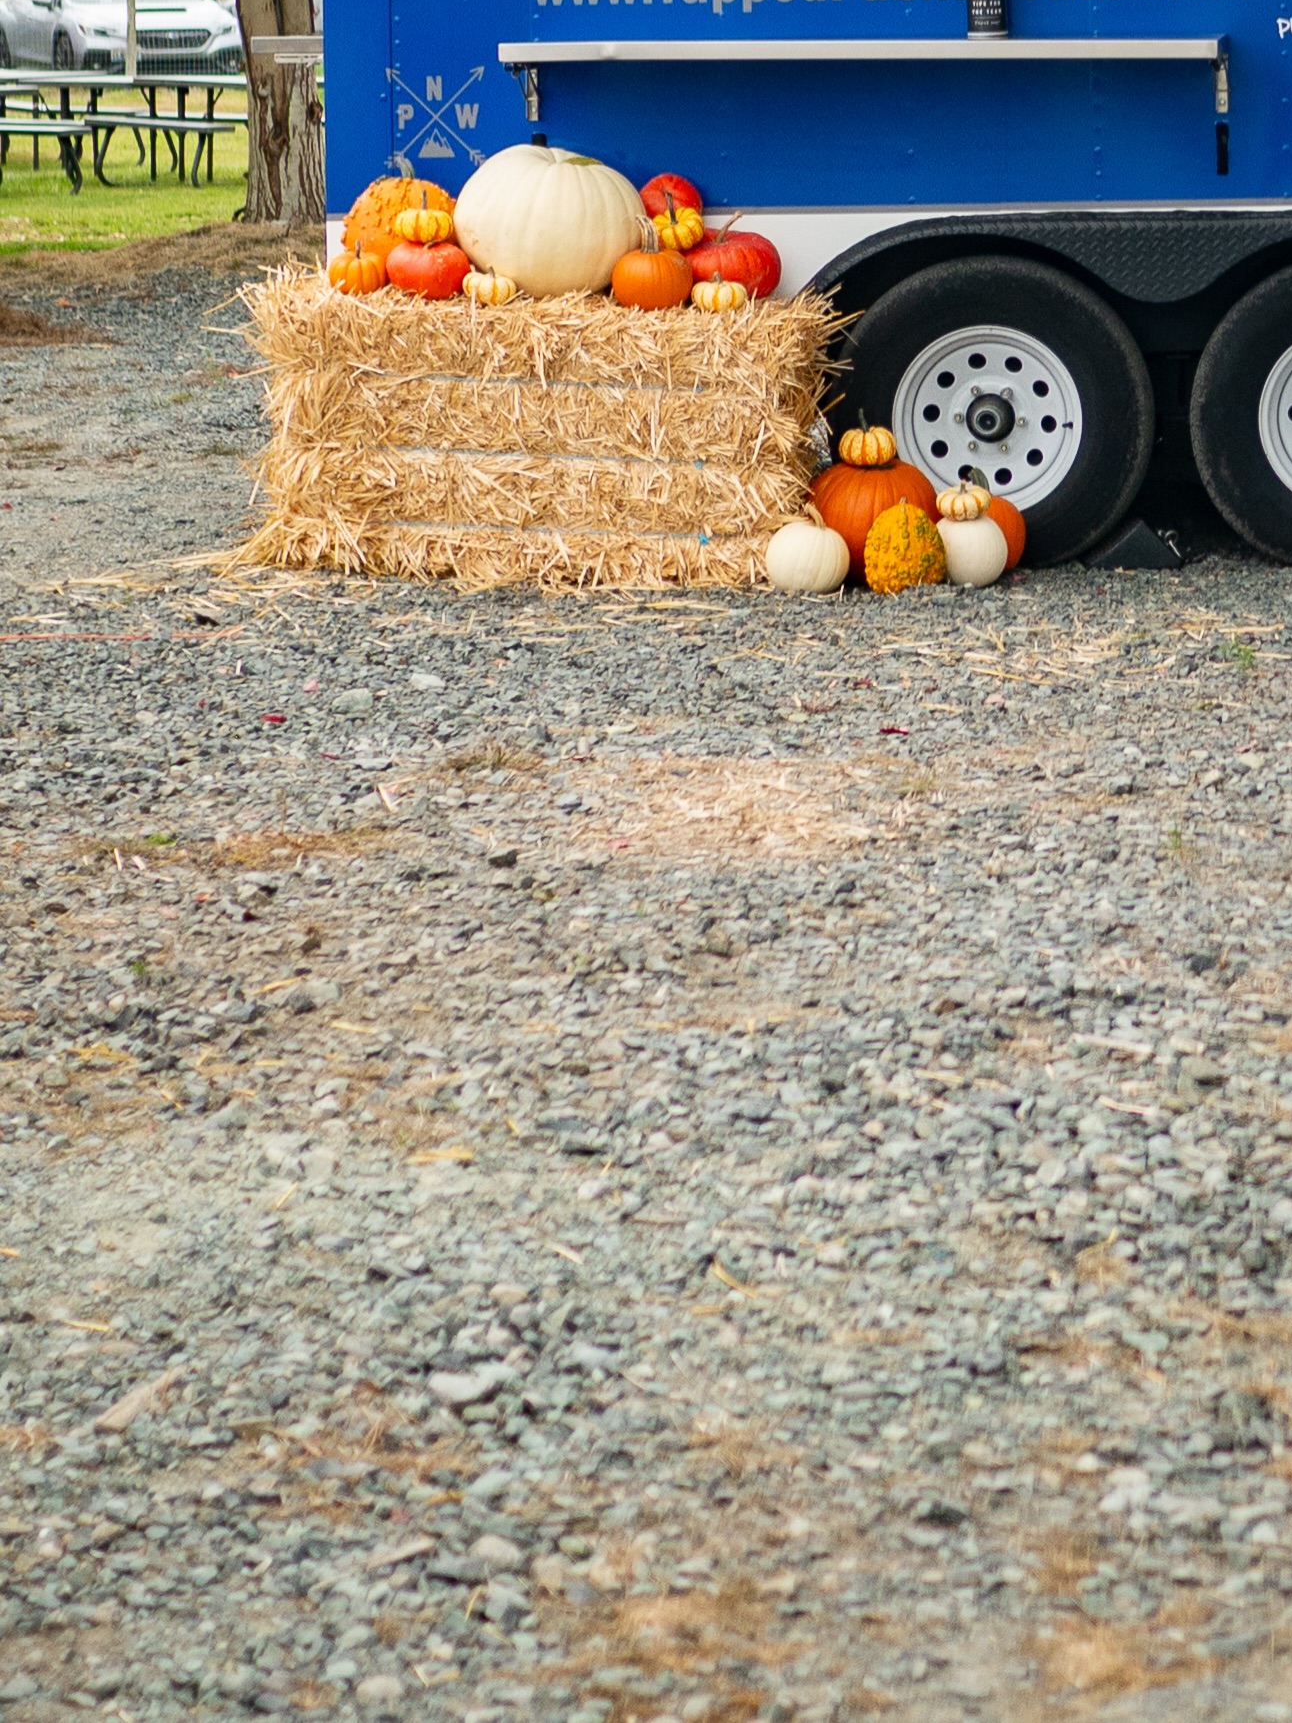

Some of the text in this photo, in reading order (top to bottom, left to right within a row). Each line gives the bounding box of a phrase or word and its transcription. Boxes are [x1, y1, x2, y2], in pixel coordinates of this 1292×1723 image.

[426, 75, 442, 101] N
[398, 103, 479, 130] P W
